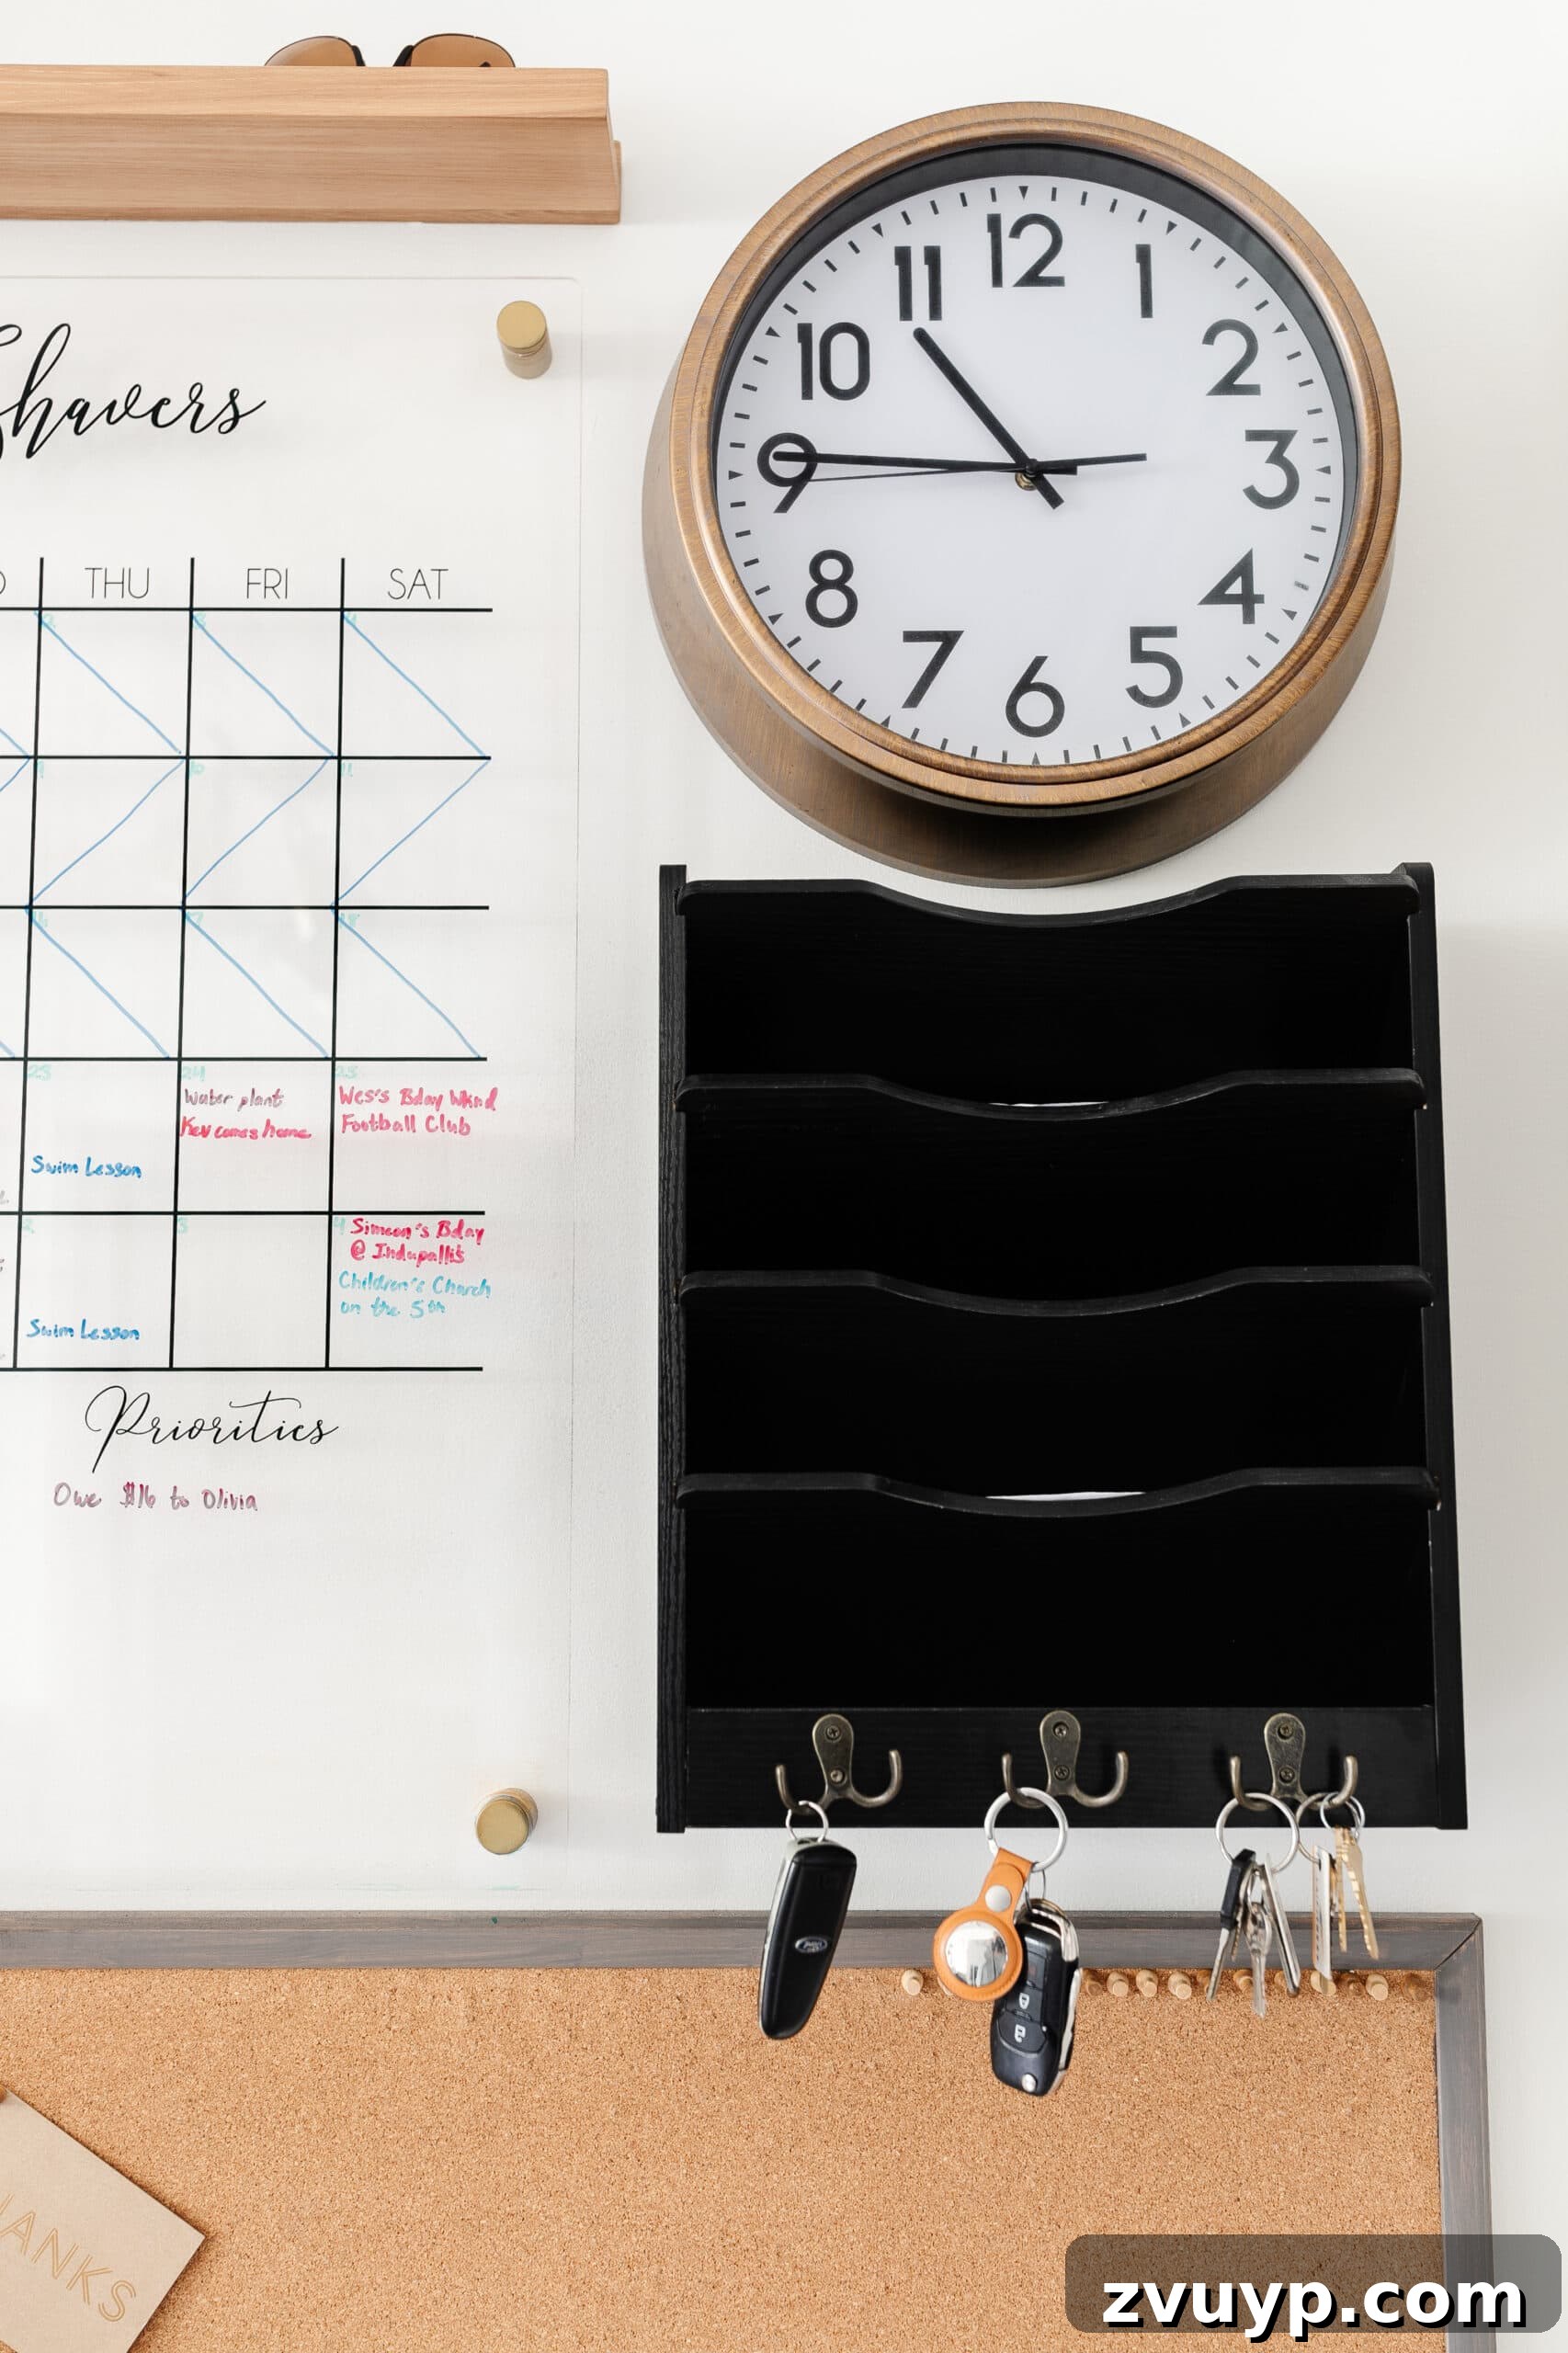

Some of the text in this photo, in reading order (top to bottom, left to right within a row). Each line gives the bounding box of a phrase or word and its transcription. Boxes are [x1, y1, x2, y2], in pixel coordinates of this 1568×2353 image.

[893, 245, 942, 321] 11
[986, 213, 1065, 288] 12
[1135, 244, 1153, 318] 1
[797, 322, 870, 401] 10
[1201, 319, 1261, 396] 2
[756, 432, 818, 513] 9
[1243, 429, 1299, 509] 3
[85, 567, 150, 599] THU
[246, 568, 289, 599] FRI
[387, 568, 449, 600] SAT
[805, 550, 858, 628] 8
[1198, 549, 1265, 624] 4
[902, 631, 964, 709] 7
[1006, 656, 1064, 738] 6
[1125, 626, 1183, 709] 5
[237, 1087, 284, 1112] plant
[341, 1113, 472, 1136] Football Club
[400, 1086, 443, 1112] Bday
[31, 1154, 142, 1178] Swim Lesson
[350, 1239, 366, 1261] @
[436, 1219, 485, 1245] Bday
[338, 1270, 492, 1299] Children's Church
[340, 1301, 361, 1315] on
[370, 1296, 401, 1318] the
[27, 1318, 141, 1341] Swim Lesson
[85, 1385, 339, 1473] Priorities
[53, 1481, 258, 1511] Owe $16 to Olivia
[0, 2193, 136, 2323] ANKS
